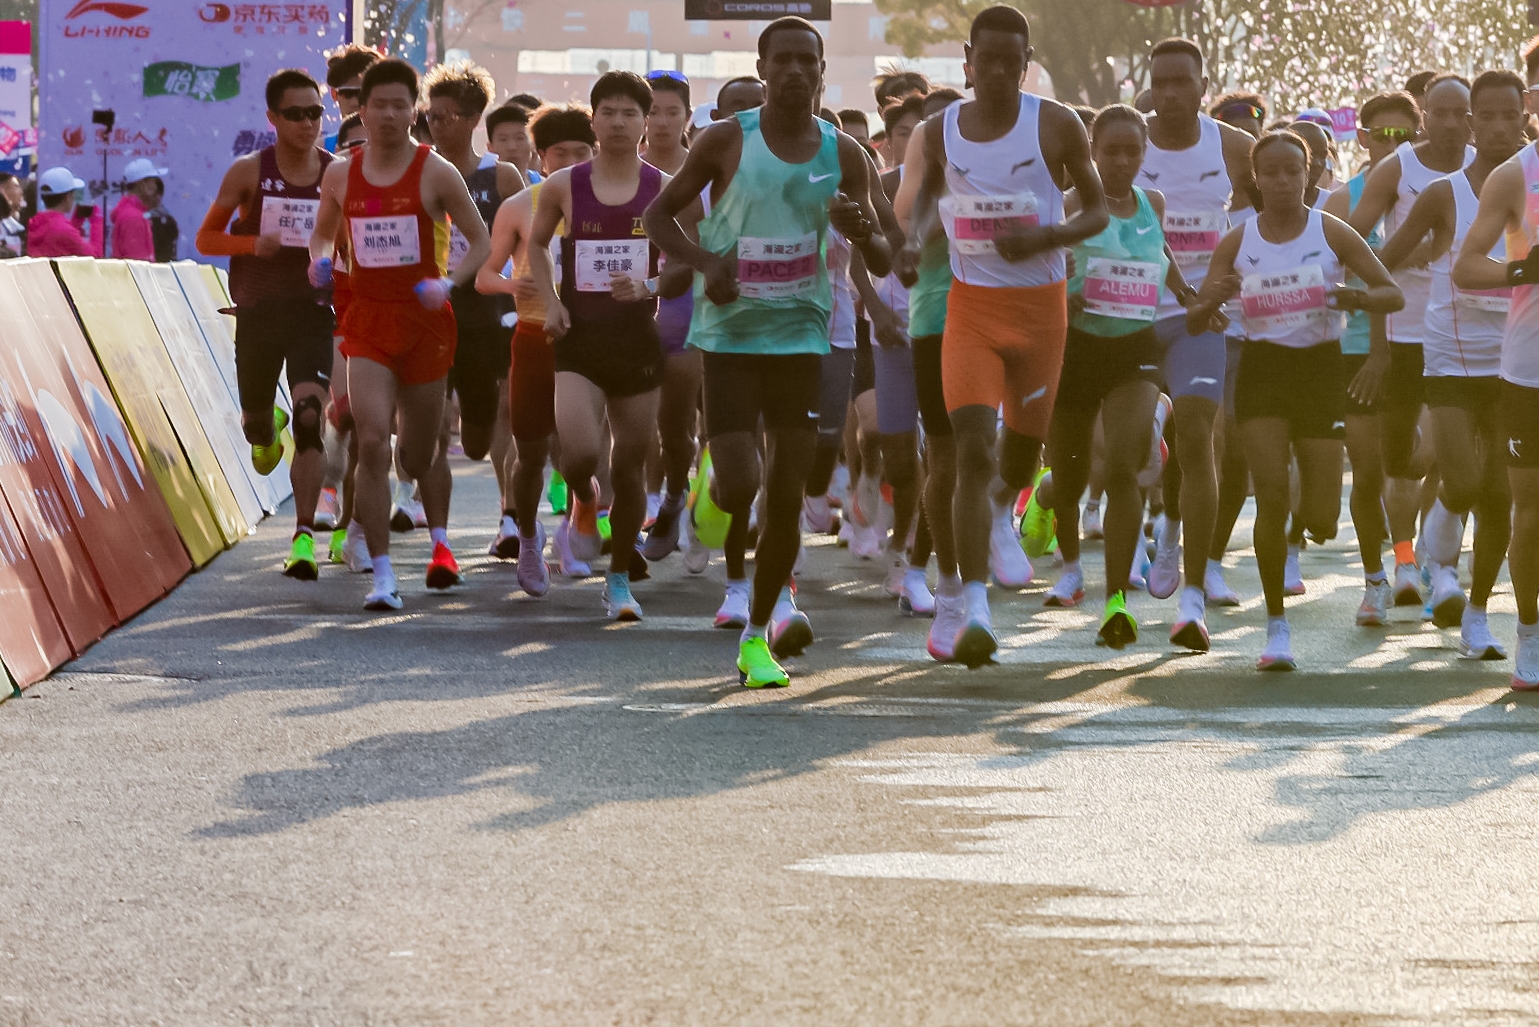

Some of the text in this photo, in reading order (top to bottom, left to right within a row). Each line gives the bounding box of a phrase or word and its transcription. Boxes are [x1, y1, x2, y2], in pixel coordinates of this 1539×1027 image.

[233, 4, 330, 24] 京东买药
[64, 25, 151, 38] LI-NING
[593, 258, 633, 272] 李佳豪
[747, 261, 797, 278] PACE
[1099, 279, 1150, 298] ALEMU
